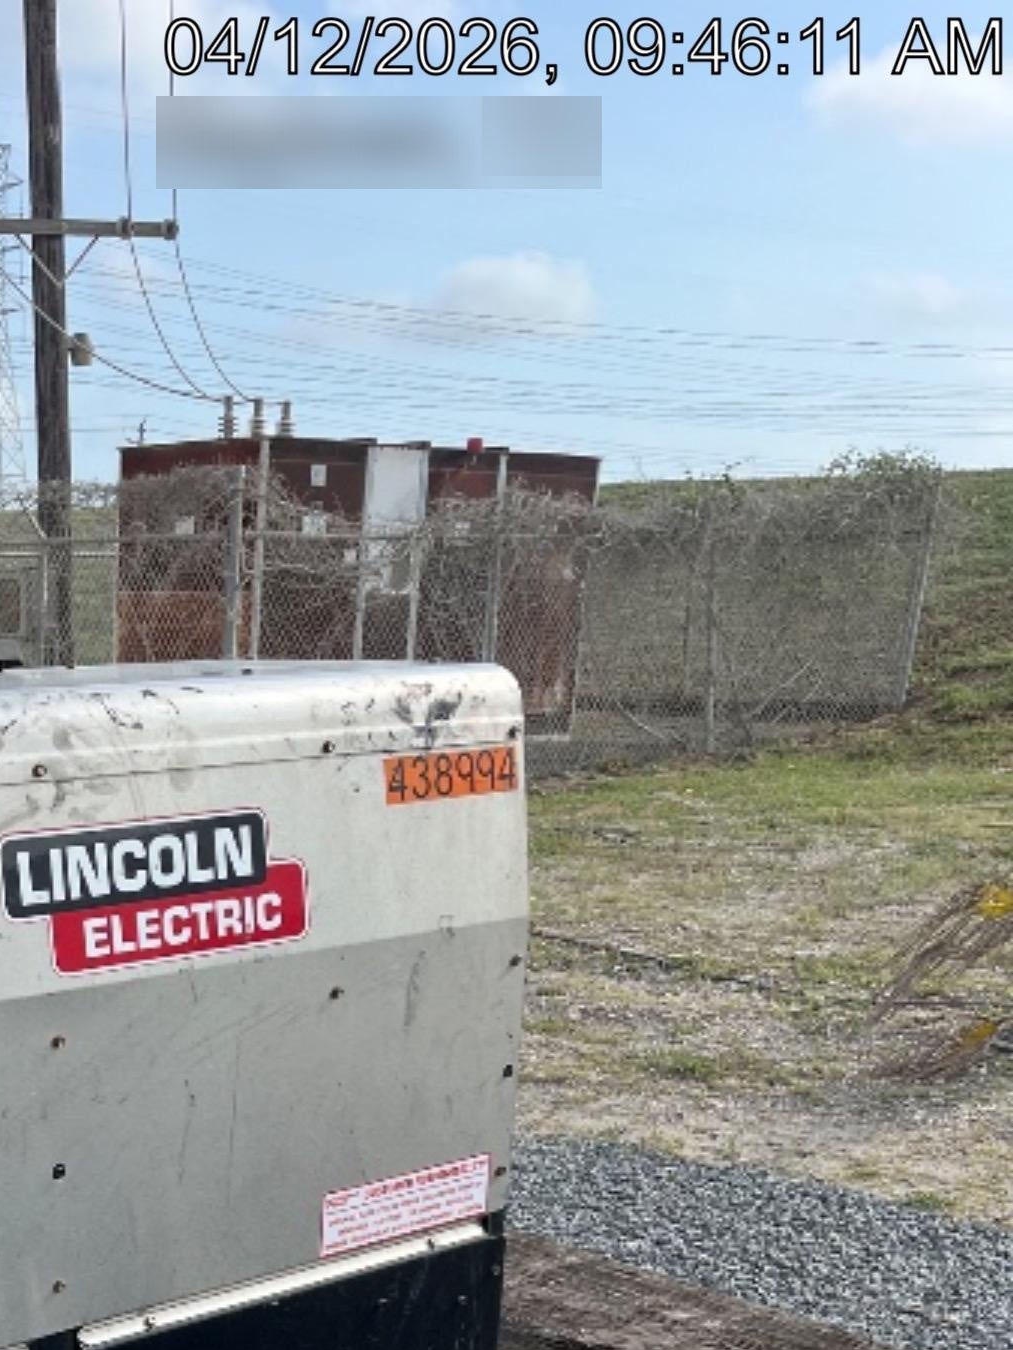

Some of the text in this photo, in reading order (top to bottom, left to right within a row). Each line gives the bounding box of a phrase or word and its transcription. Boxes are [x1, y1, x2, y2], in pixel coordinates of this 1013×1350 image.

[388, 748, 517, 801] 438994
[16, 824, 255, 907] LINCOLN
[83, 893, 283, 959] ELECTRIC
